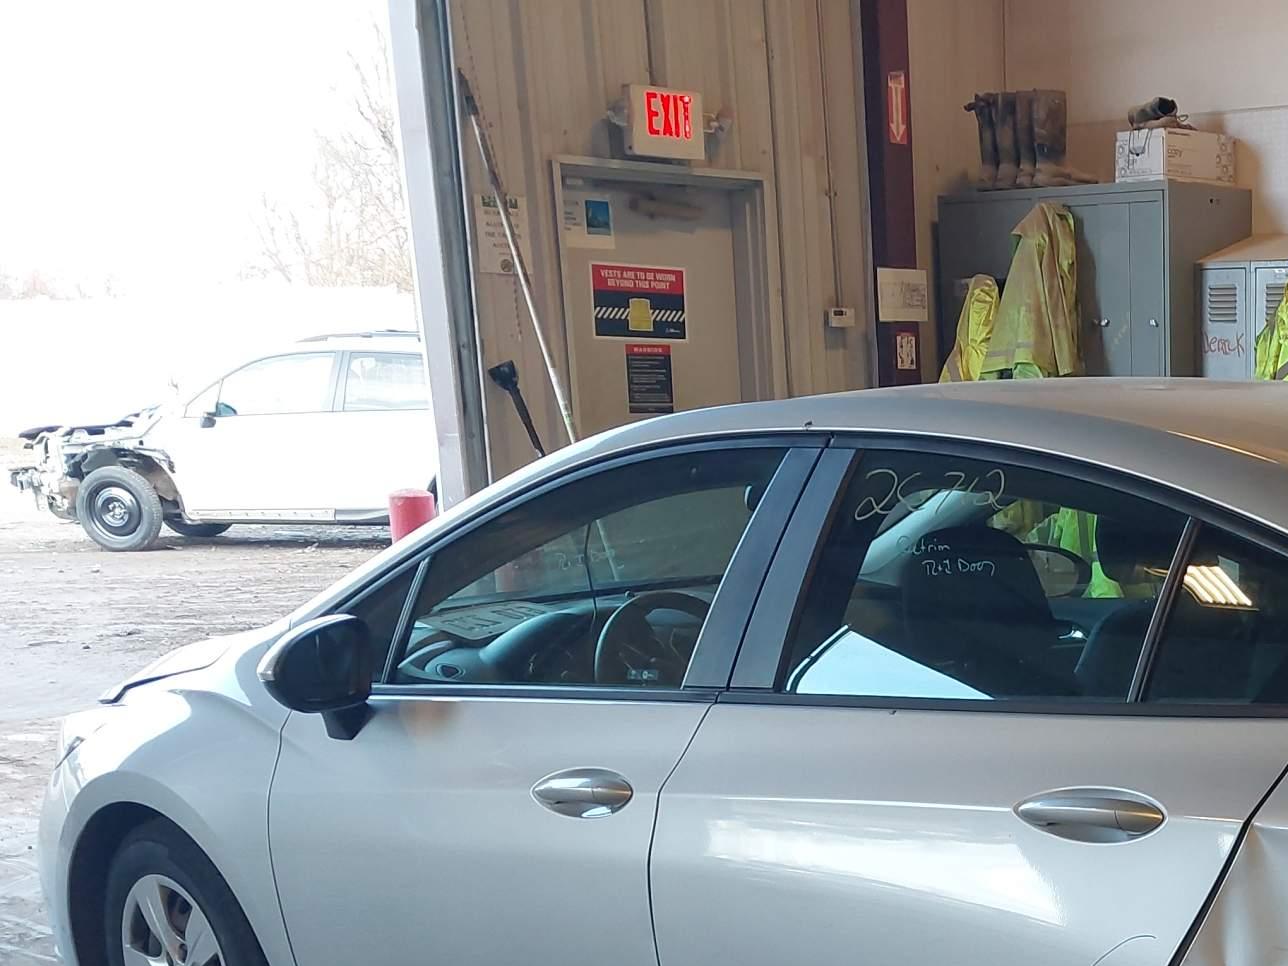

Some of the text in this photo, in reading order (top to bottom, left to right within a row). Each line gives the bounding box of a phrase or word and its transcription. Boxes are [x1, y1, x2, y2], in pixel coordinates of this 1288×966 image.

[644, 90, 692, 140] EXIT
[600, 269, 676, 282] VESTS ARE TO BE WORN
[607, 278, 670, 290] BEYOND THIS POINT
